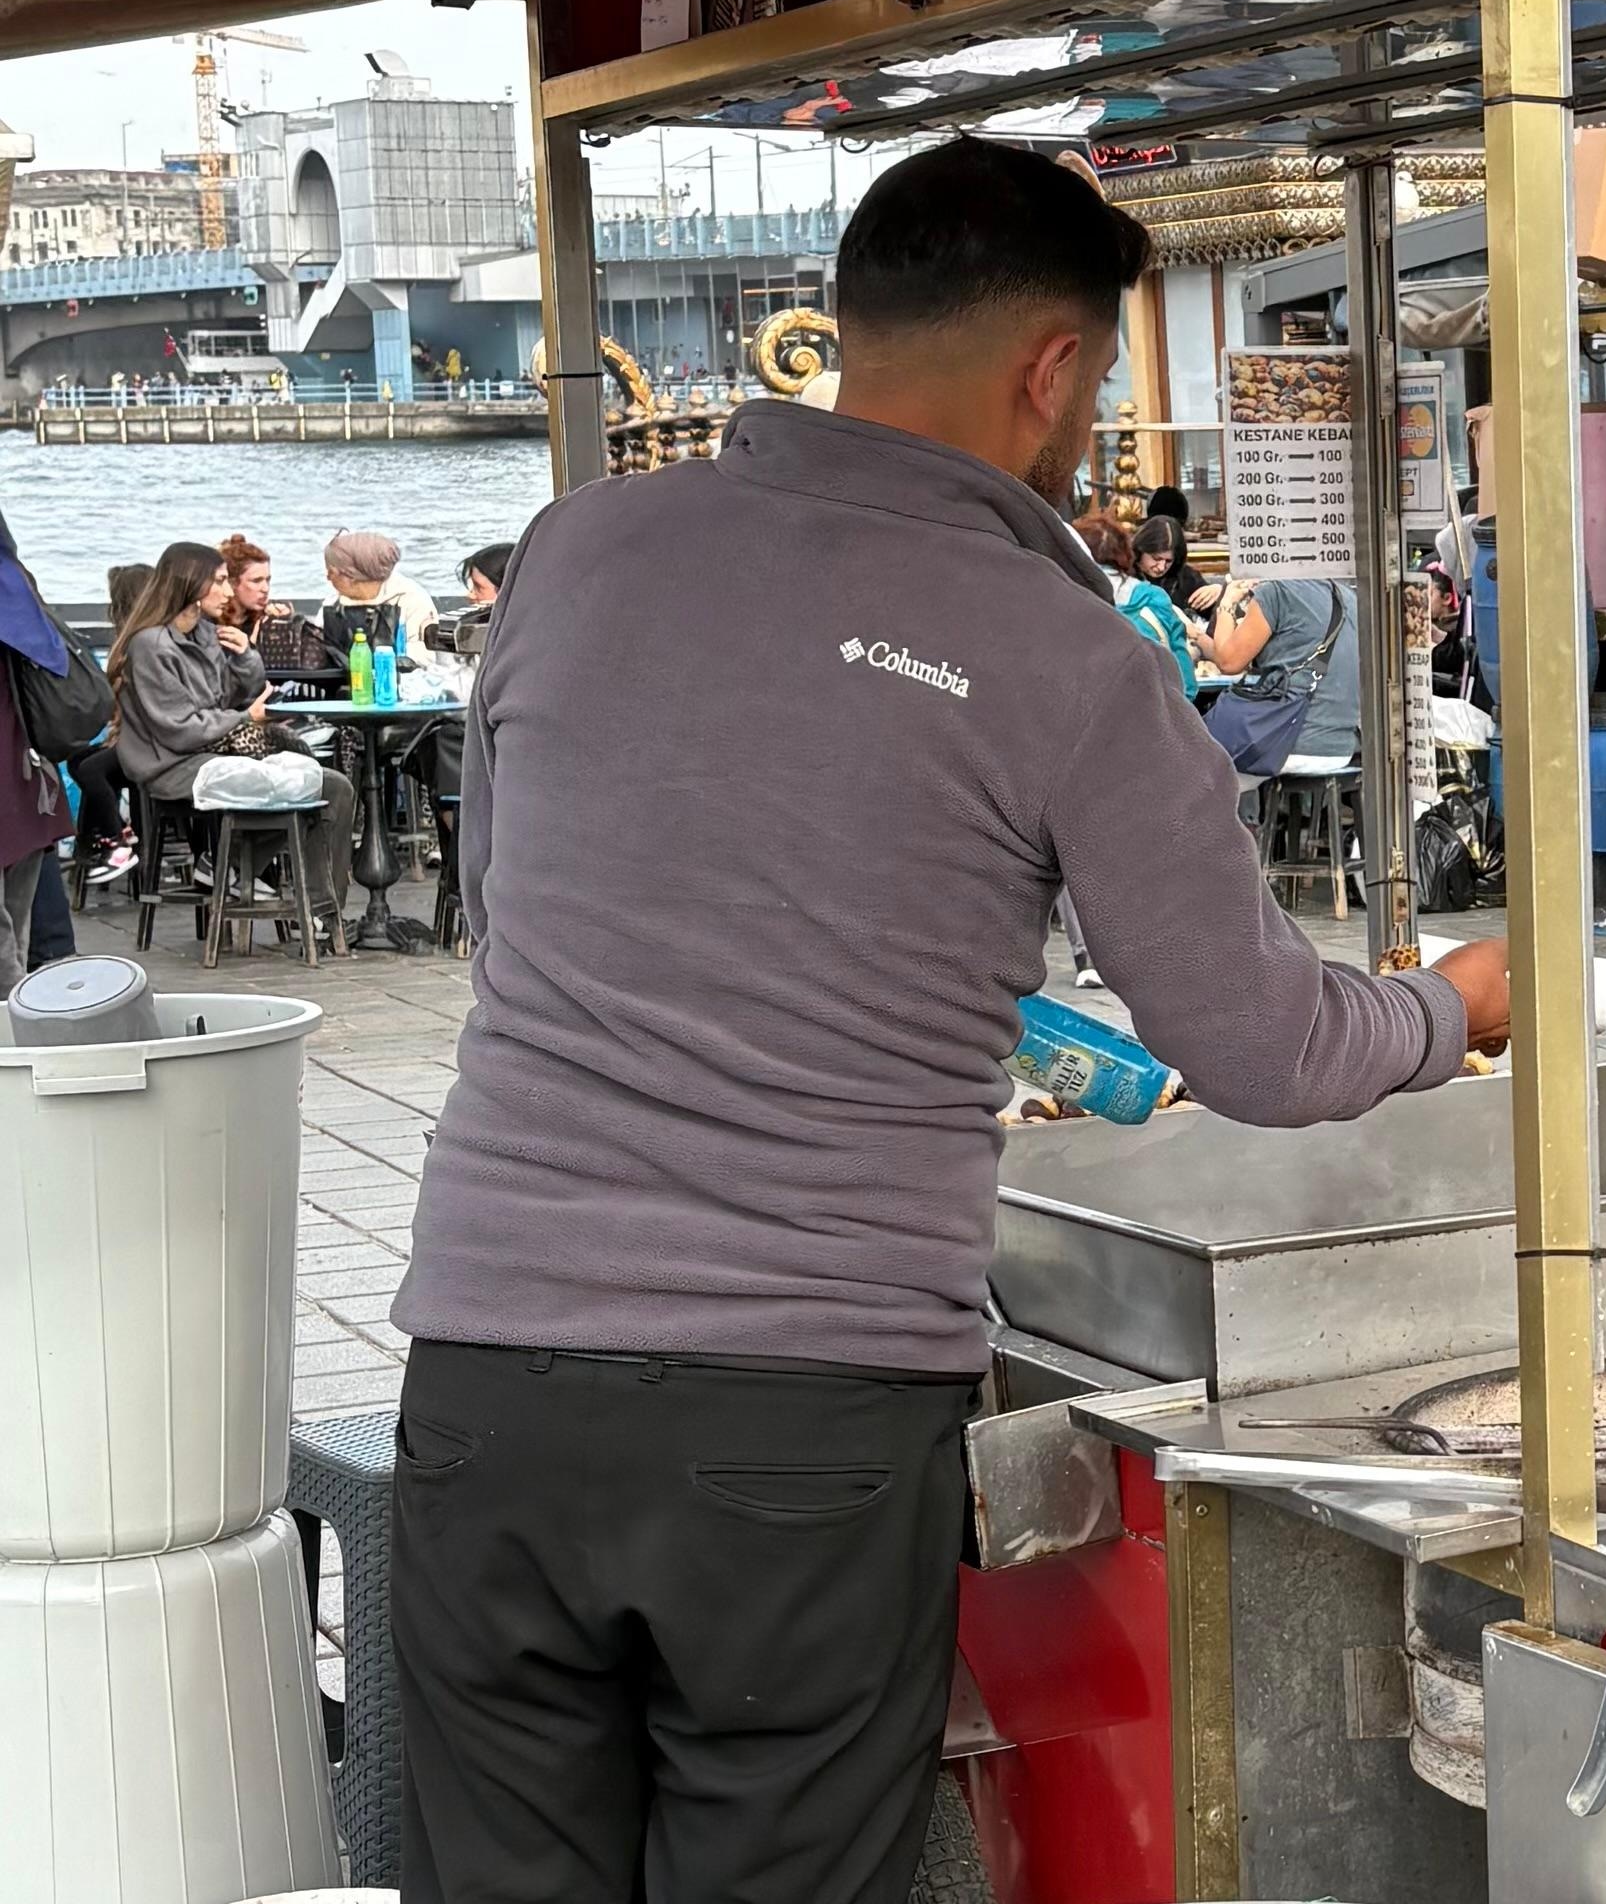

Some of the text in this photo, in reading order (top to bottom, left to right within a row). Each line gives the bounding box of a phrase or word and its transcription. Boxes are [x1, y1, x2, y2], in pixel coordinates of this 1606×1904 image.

[1234, 429, 1303, 442] KESTANE
[1236, 450, 1342, 463] 100 Gr. 100
[1237, 472, 1343, 485] 200 Gr. 200
[1238, 493, 1345, 506] 300 Gr. 300
[1239, 513, 1345, 528] 400 Gr. 400
[1239, 533, 1346, 548] 500 Gr. 500
[1239, 550, 1350, 565] 1000 Gr. 1000
[867, 641, 969, 698] Columbia
